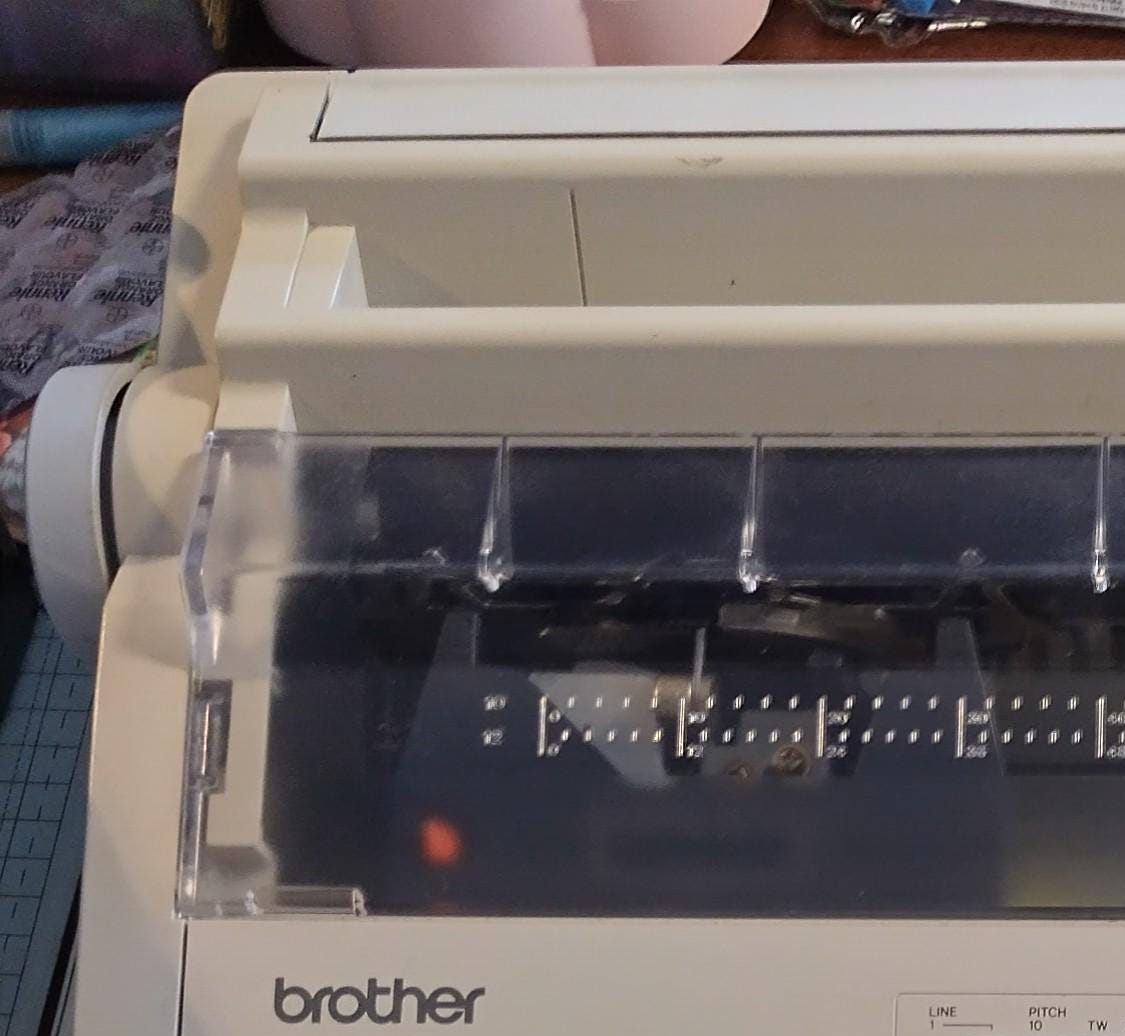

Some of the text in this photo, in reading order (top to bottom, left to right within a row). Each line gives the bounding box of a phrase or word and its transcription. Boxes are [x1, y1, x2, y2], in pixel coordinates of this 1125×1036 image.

[8, 285, 72, 302] Rennie
[93, 288, 159, 308] Rennie
[274, 977, 485, 1024] brother
[929, 1006, 957, 1018] LINE
[1028, 1007, 1067, 1018] PITCH
[931, 1020, 934, 1029] 1
[1030, 1020, 1042, 1031] 10
[1090, 1021, 1107, 1031] TW
